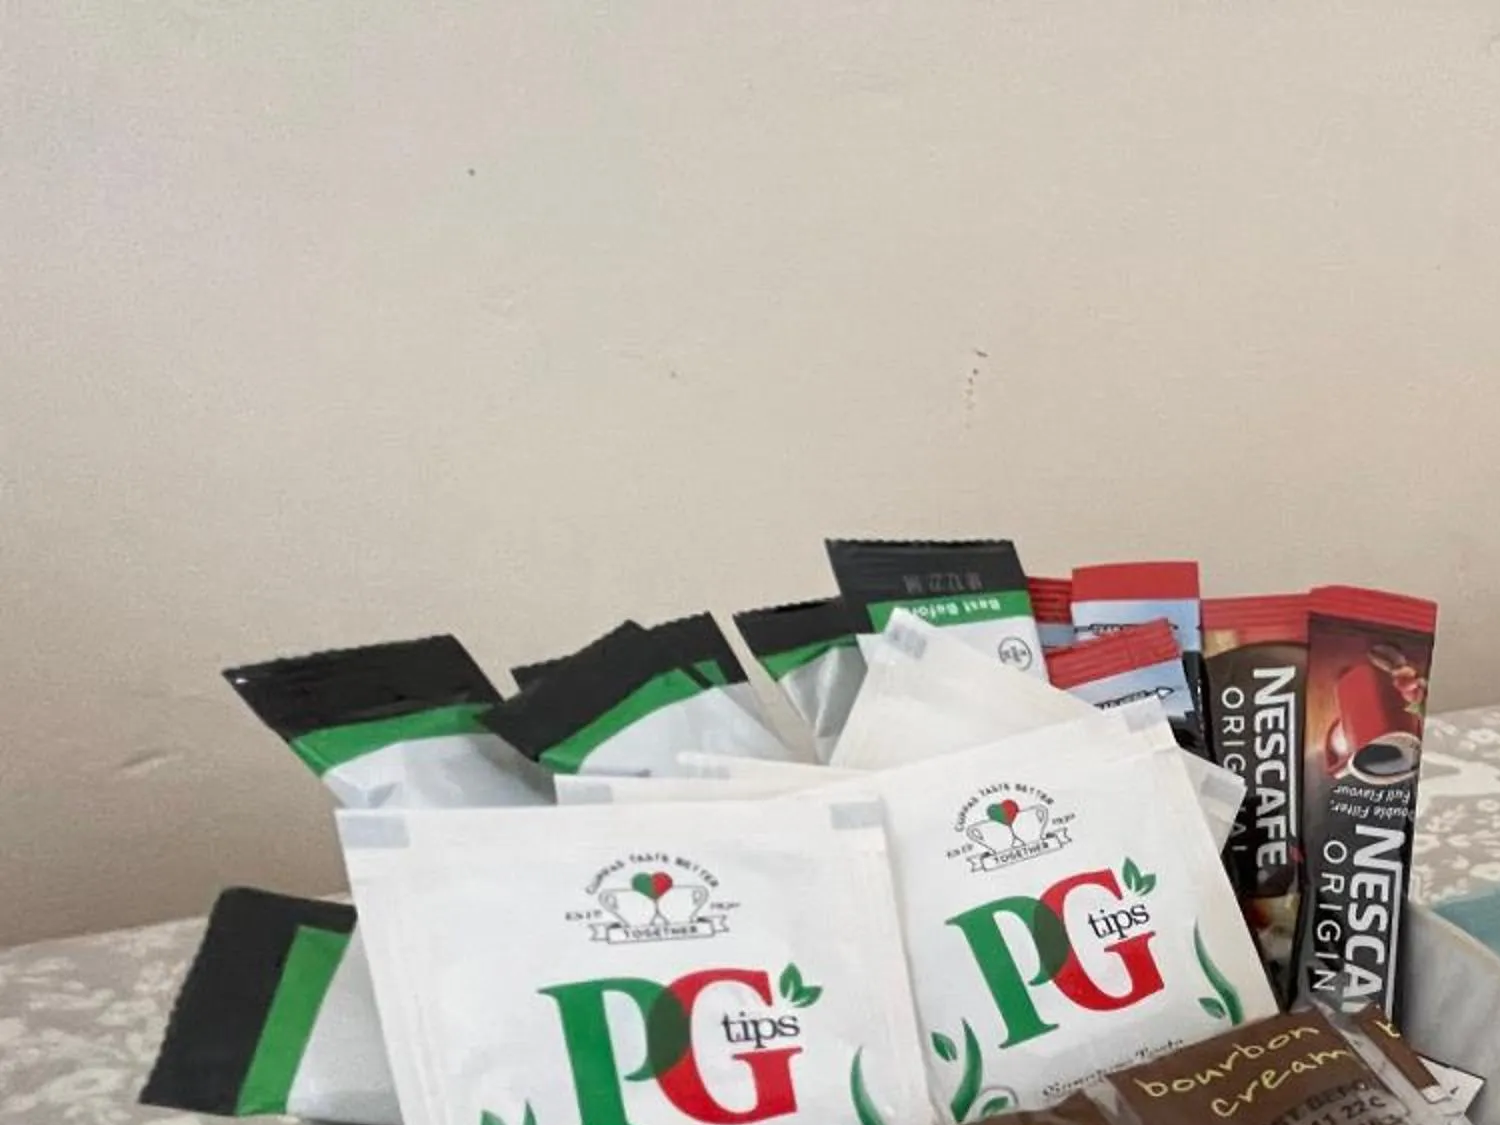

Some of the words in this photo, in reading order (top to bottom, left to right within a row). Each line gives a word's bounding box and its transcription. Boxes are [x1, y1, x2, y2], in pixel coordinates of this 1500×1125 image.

[911, 601, 959, 618] Befor
[1312, 839, 1347, 993] ORIGIN
[945, 867, 1166, 1051] PG
[1087, 901, 1151, 941] tips
[720, 1010, 801, 1049] tips
[1133, 1024, 1320, 1099] bourbon
[1210, 1045, 1352, 1119] cream
